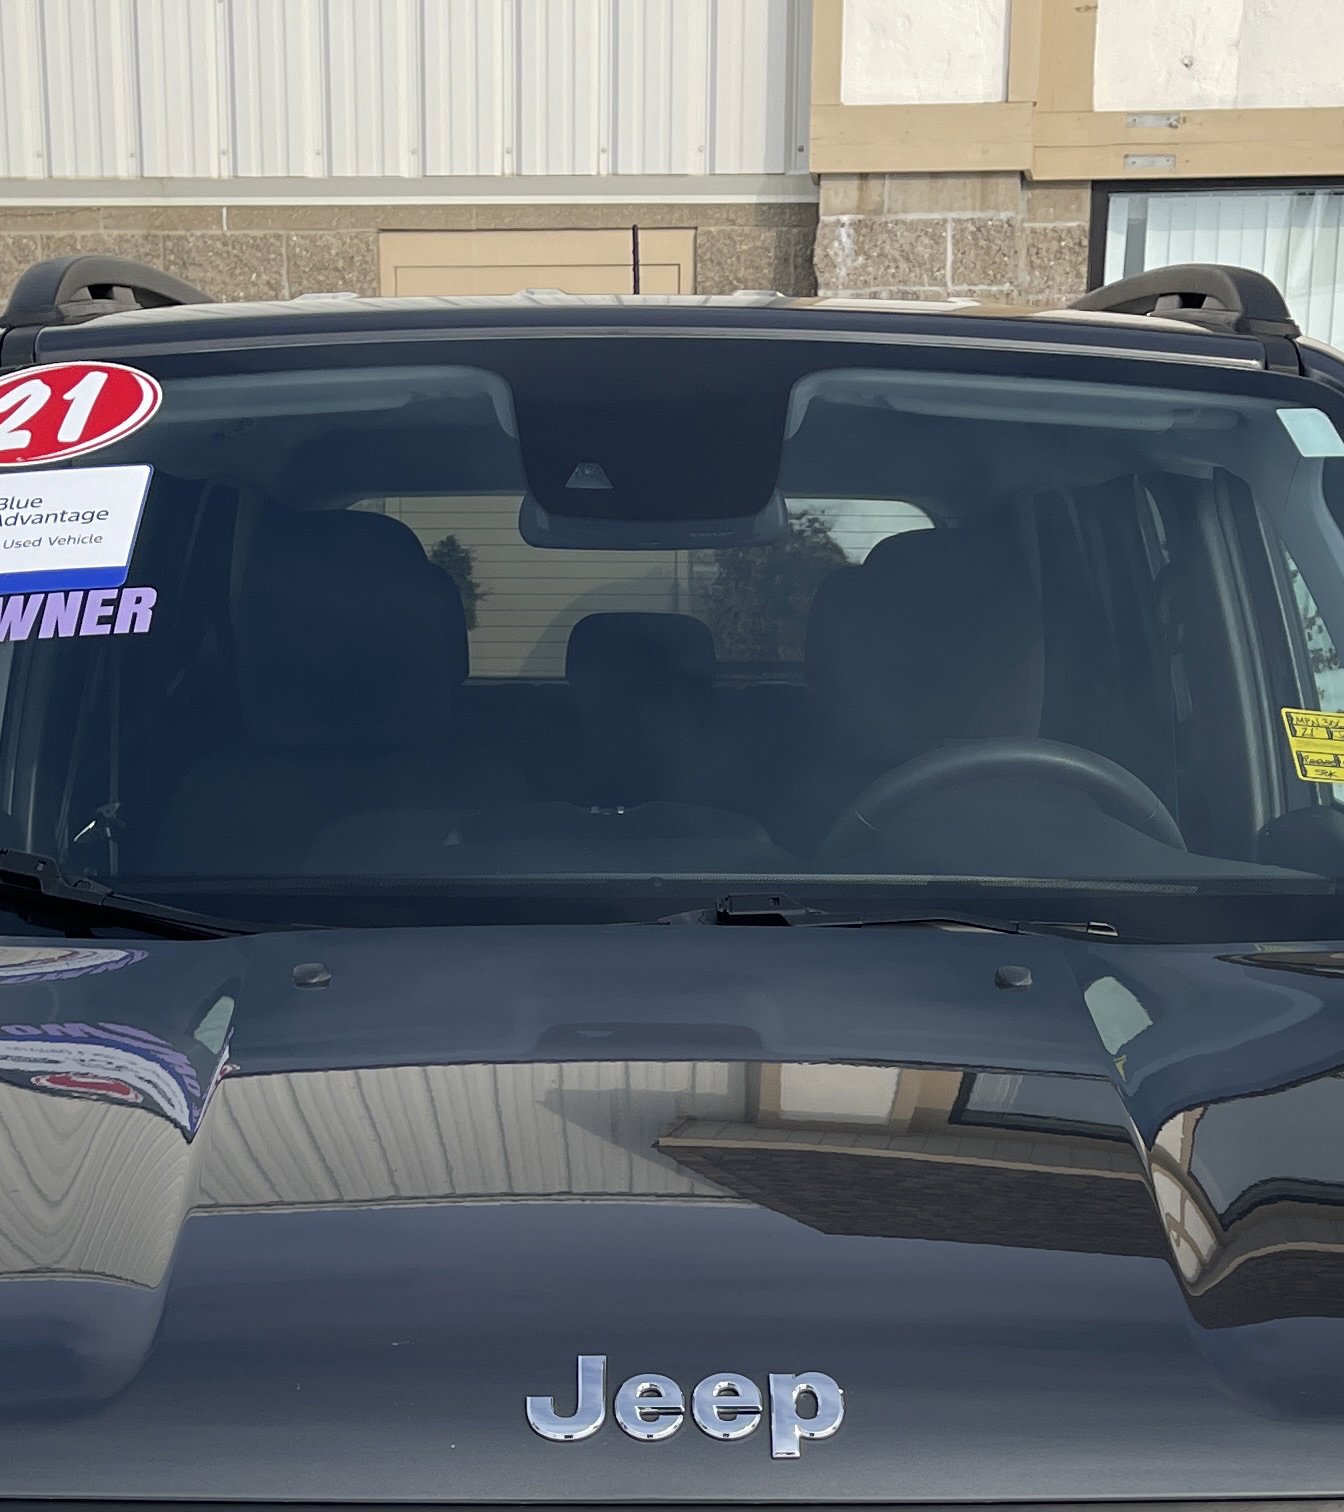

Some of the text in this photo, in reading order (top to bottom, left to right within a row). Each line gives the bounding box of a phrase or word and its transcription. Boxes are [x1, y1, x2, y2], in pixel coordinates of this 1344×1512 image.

[3, 536, 42, 550] Used
[48, 534, 103, 547] Vehicle
[525, 1354, 844, 1459] Jeep
